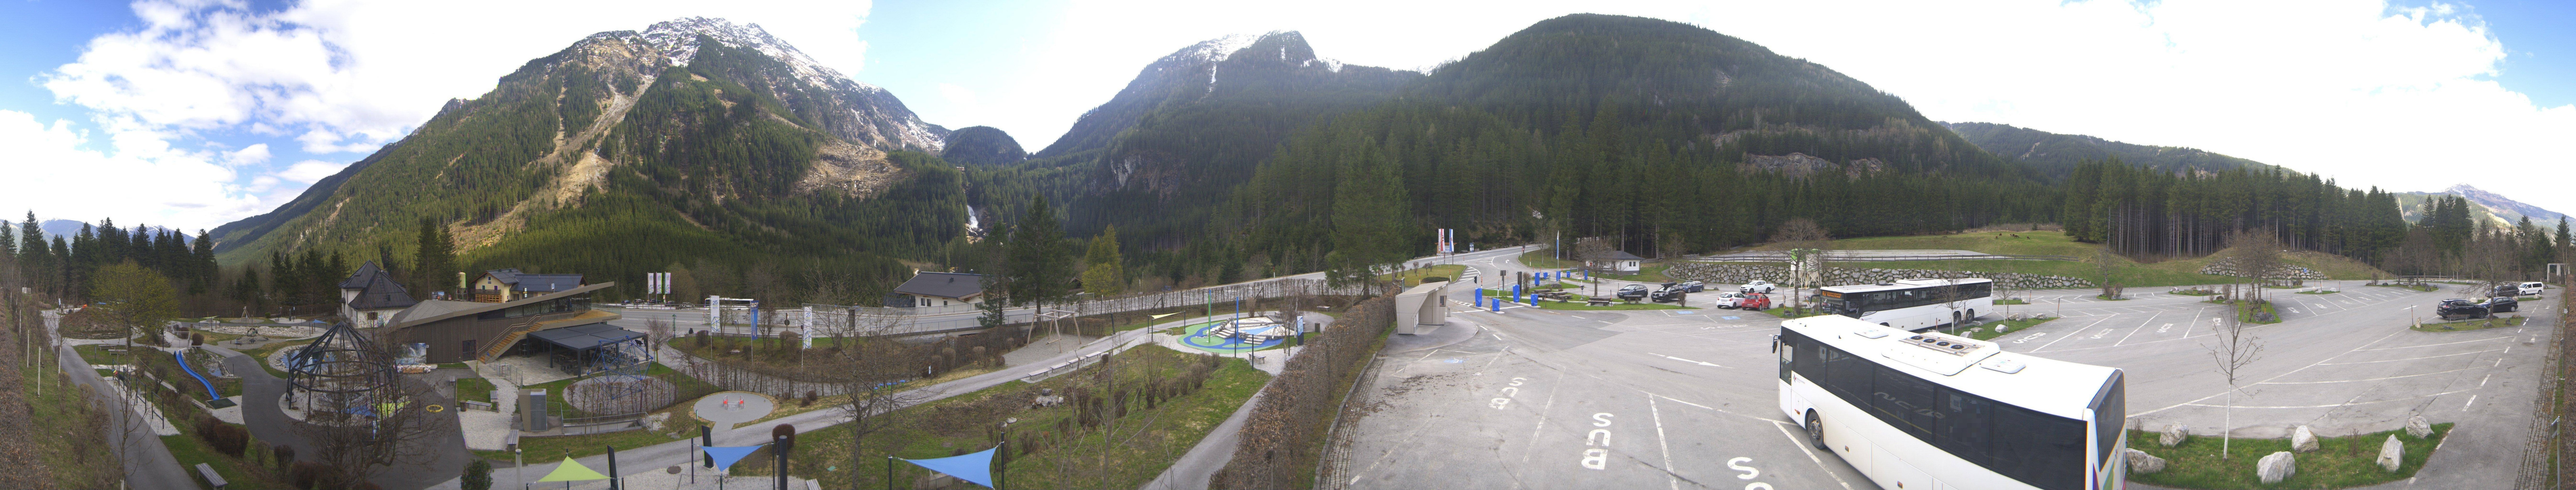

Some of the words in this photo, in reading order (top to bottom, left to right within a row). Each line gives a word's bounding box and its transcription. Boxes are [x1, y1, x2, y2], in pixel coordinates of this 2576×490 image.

[2012, 332, 2046, 344] BUS
[2156, 323, 2174, 333] BUS
[1488, 377, 1527, 410] BUS
[1581, 413, 1614, 470] BUS
